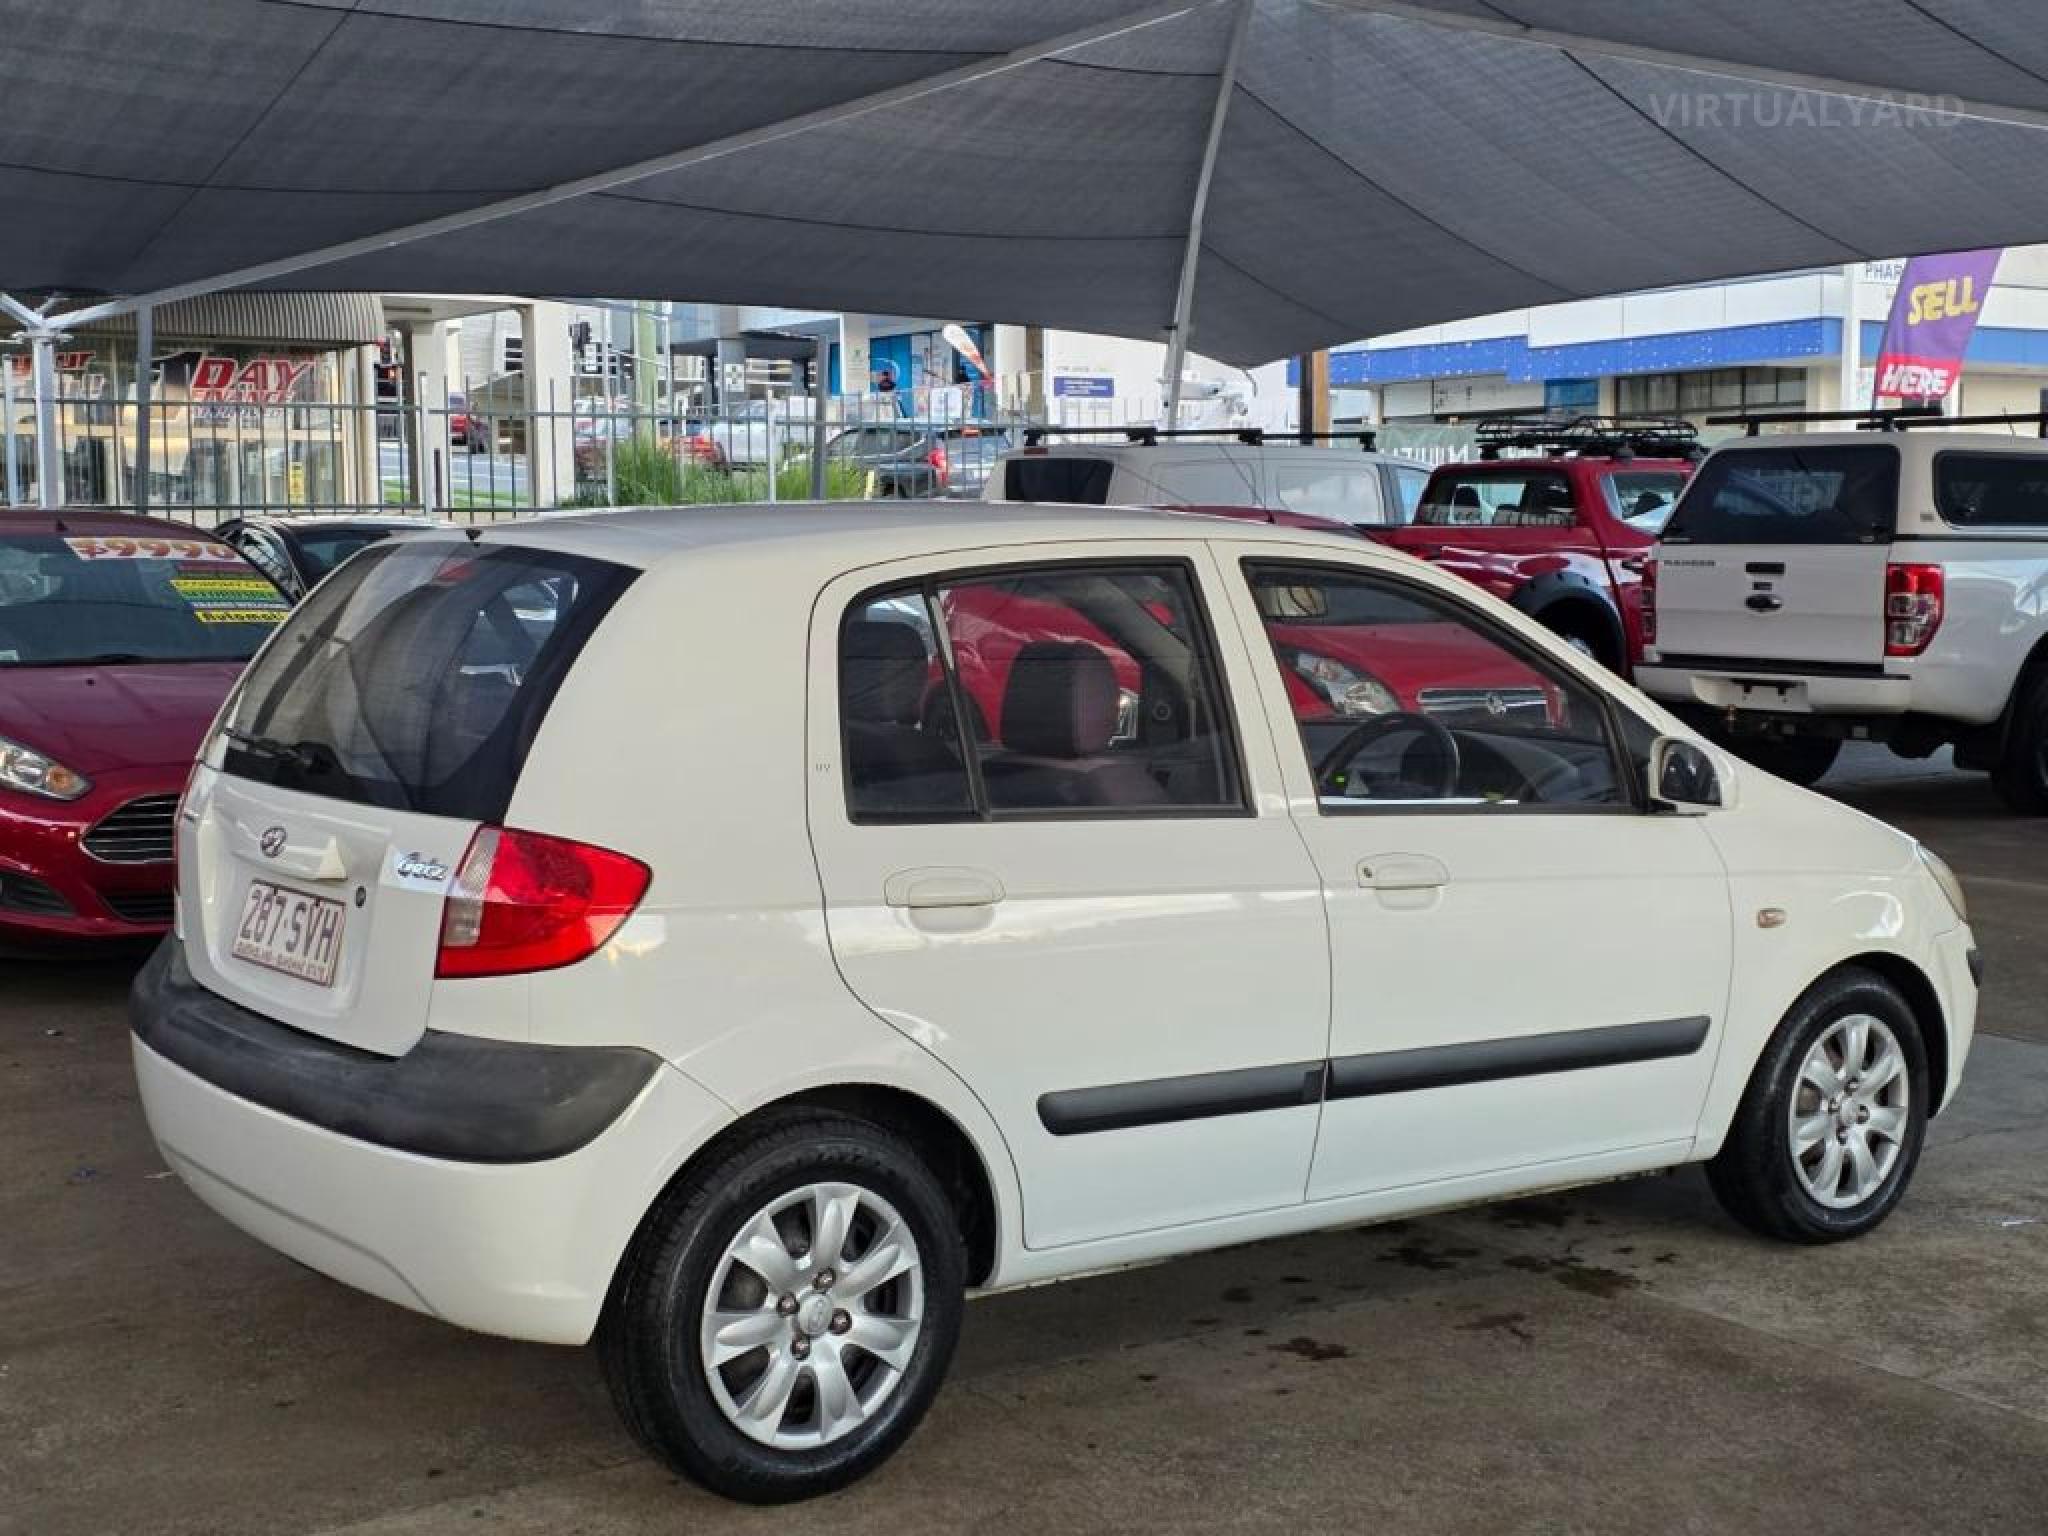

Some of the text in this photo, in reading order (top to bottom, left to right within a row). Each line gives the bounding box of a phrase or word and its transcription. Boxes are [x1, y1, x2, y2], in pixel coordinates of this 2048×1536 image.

[1907, 275, 1978, 326] SELL
[190, 357, 317, 391] DAY
[1880, 362, 1951, 395] HERE
